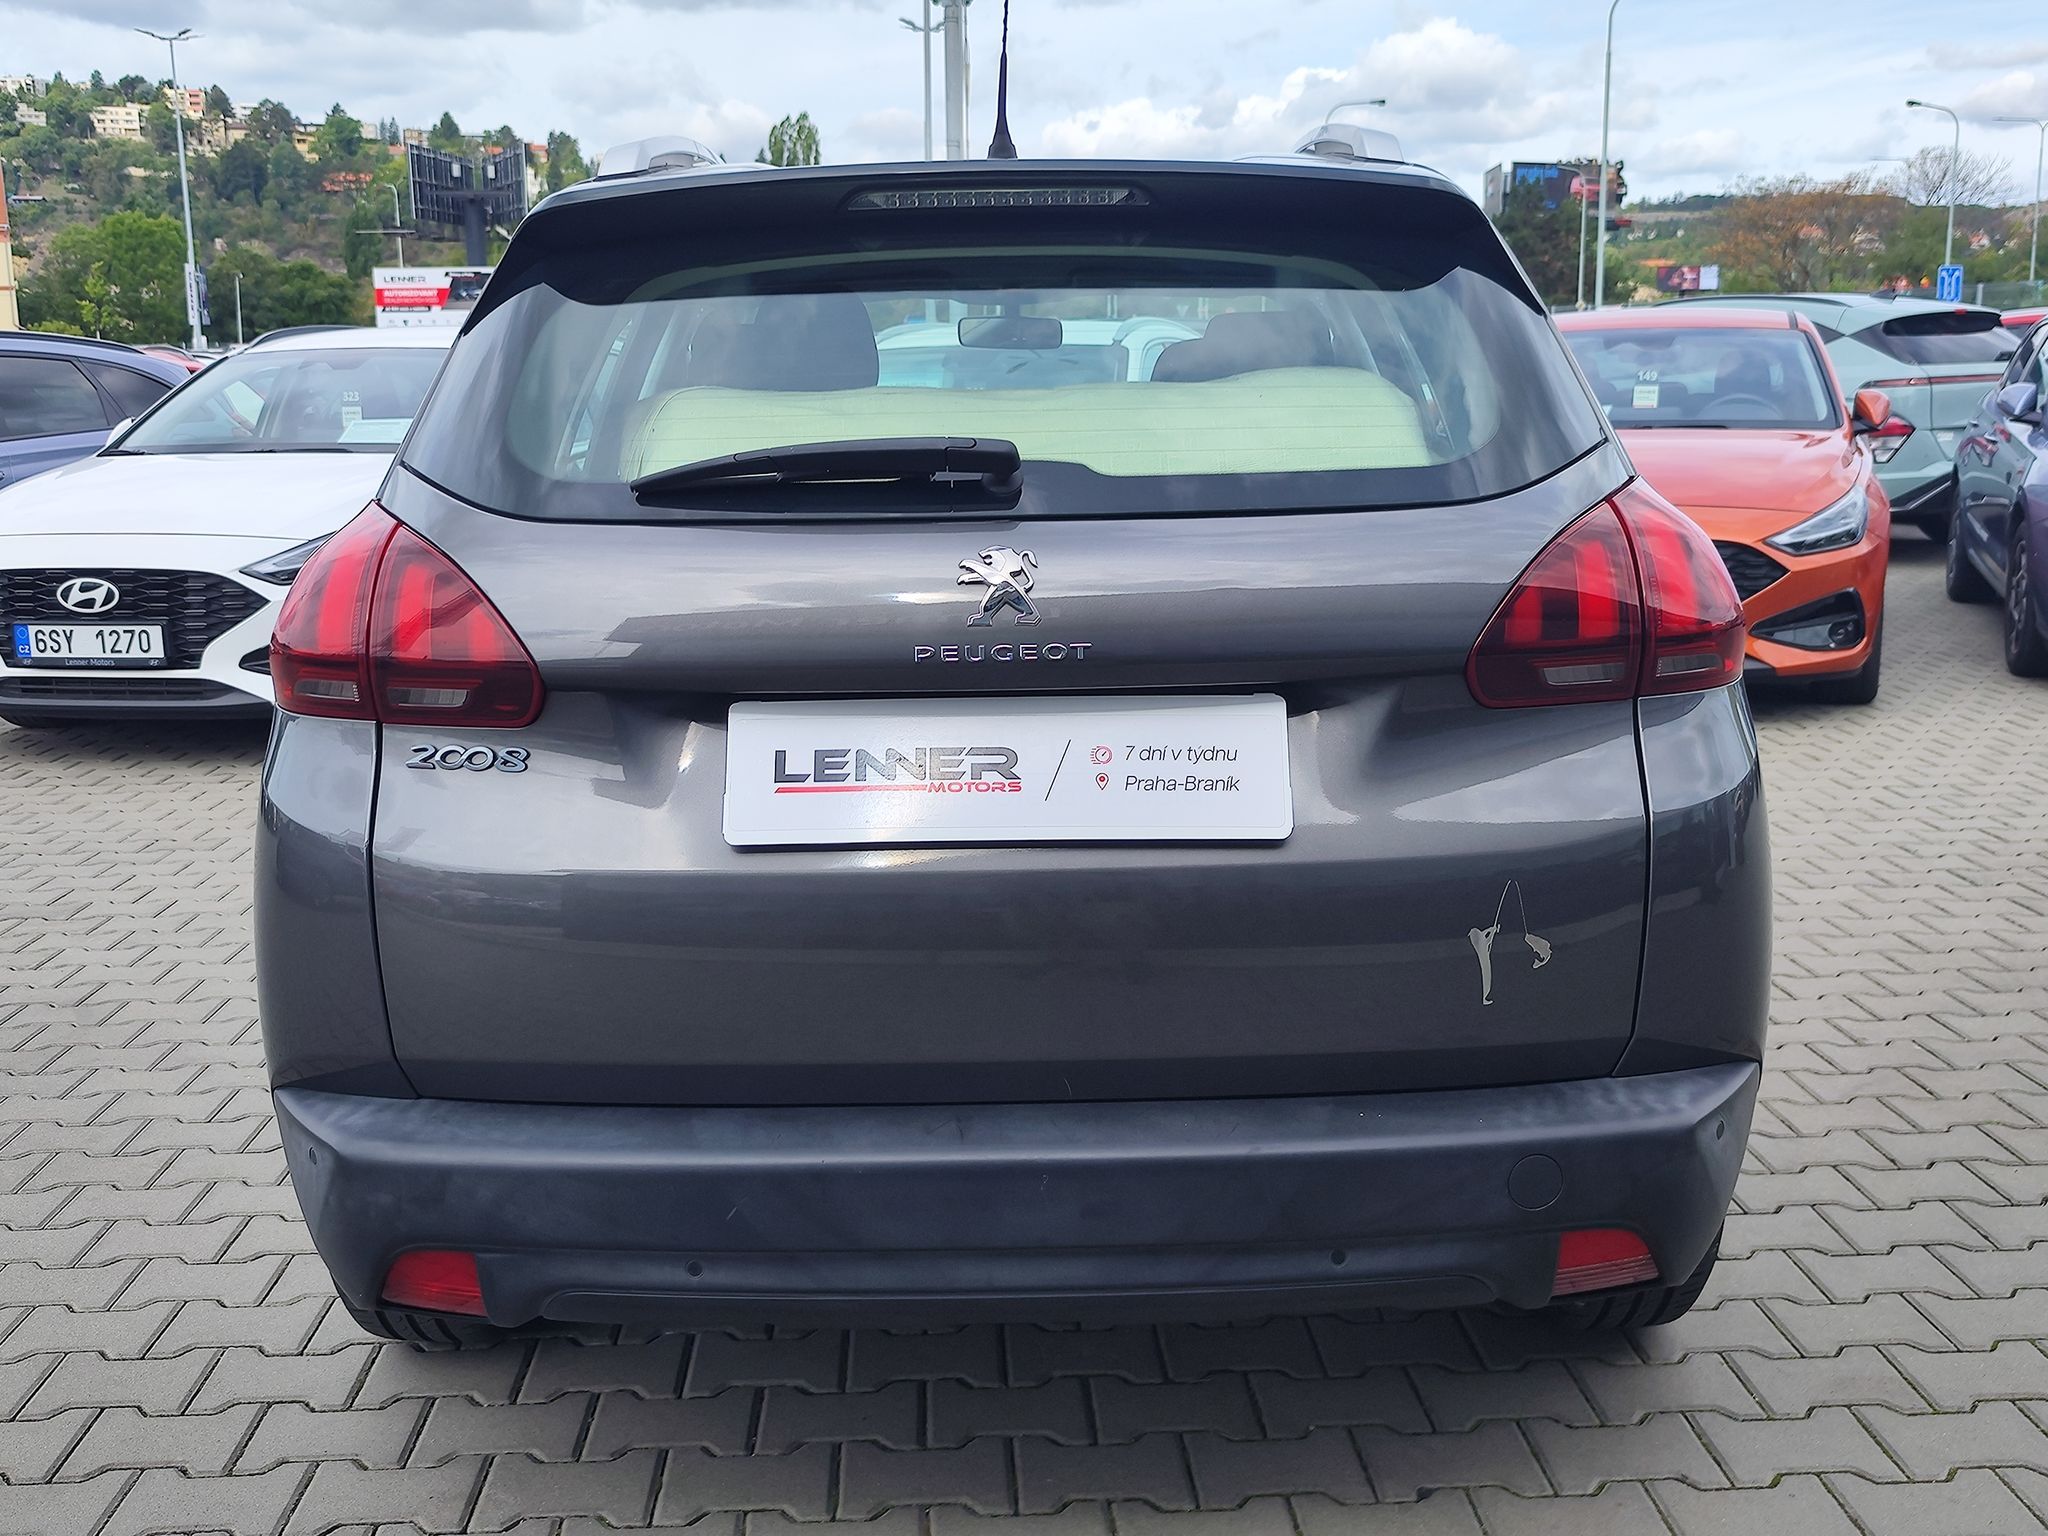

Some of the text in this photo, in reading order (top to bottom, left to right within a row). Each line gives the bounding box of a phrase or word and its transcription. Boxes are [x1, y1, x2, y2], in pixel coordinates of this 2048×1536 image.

[1637, 370, 1658, 381] 149
[343, 391, 360, 402] 323
[18, 645, 31, 654] CZ
[34, 629, 151, 654] 6SY 1270
[913, 642, 1093, 662] PEUGEOT
[65, 658, 115, 666] Lenner Motors
[405, 743, 531, 773] 2008
[1125, 745, 1238, 765] 7 dní v týdnu
[773, 746, 1022, 783] LENNER
[927, 781, 1022, 793] MOTORS
[1124, 775, 1241, 792] Praha-Braník
